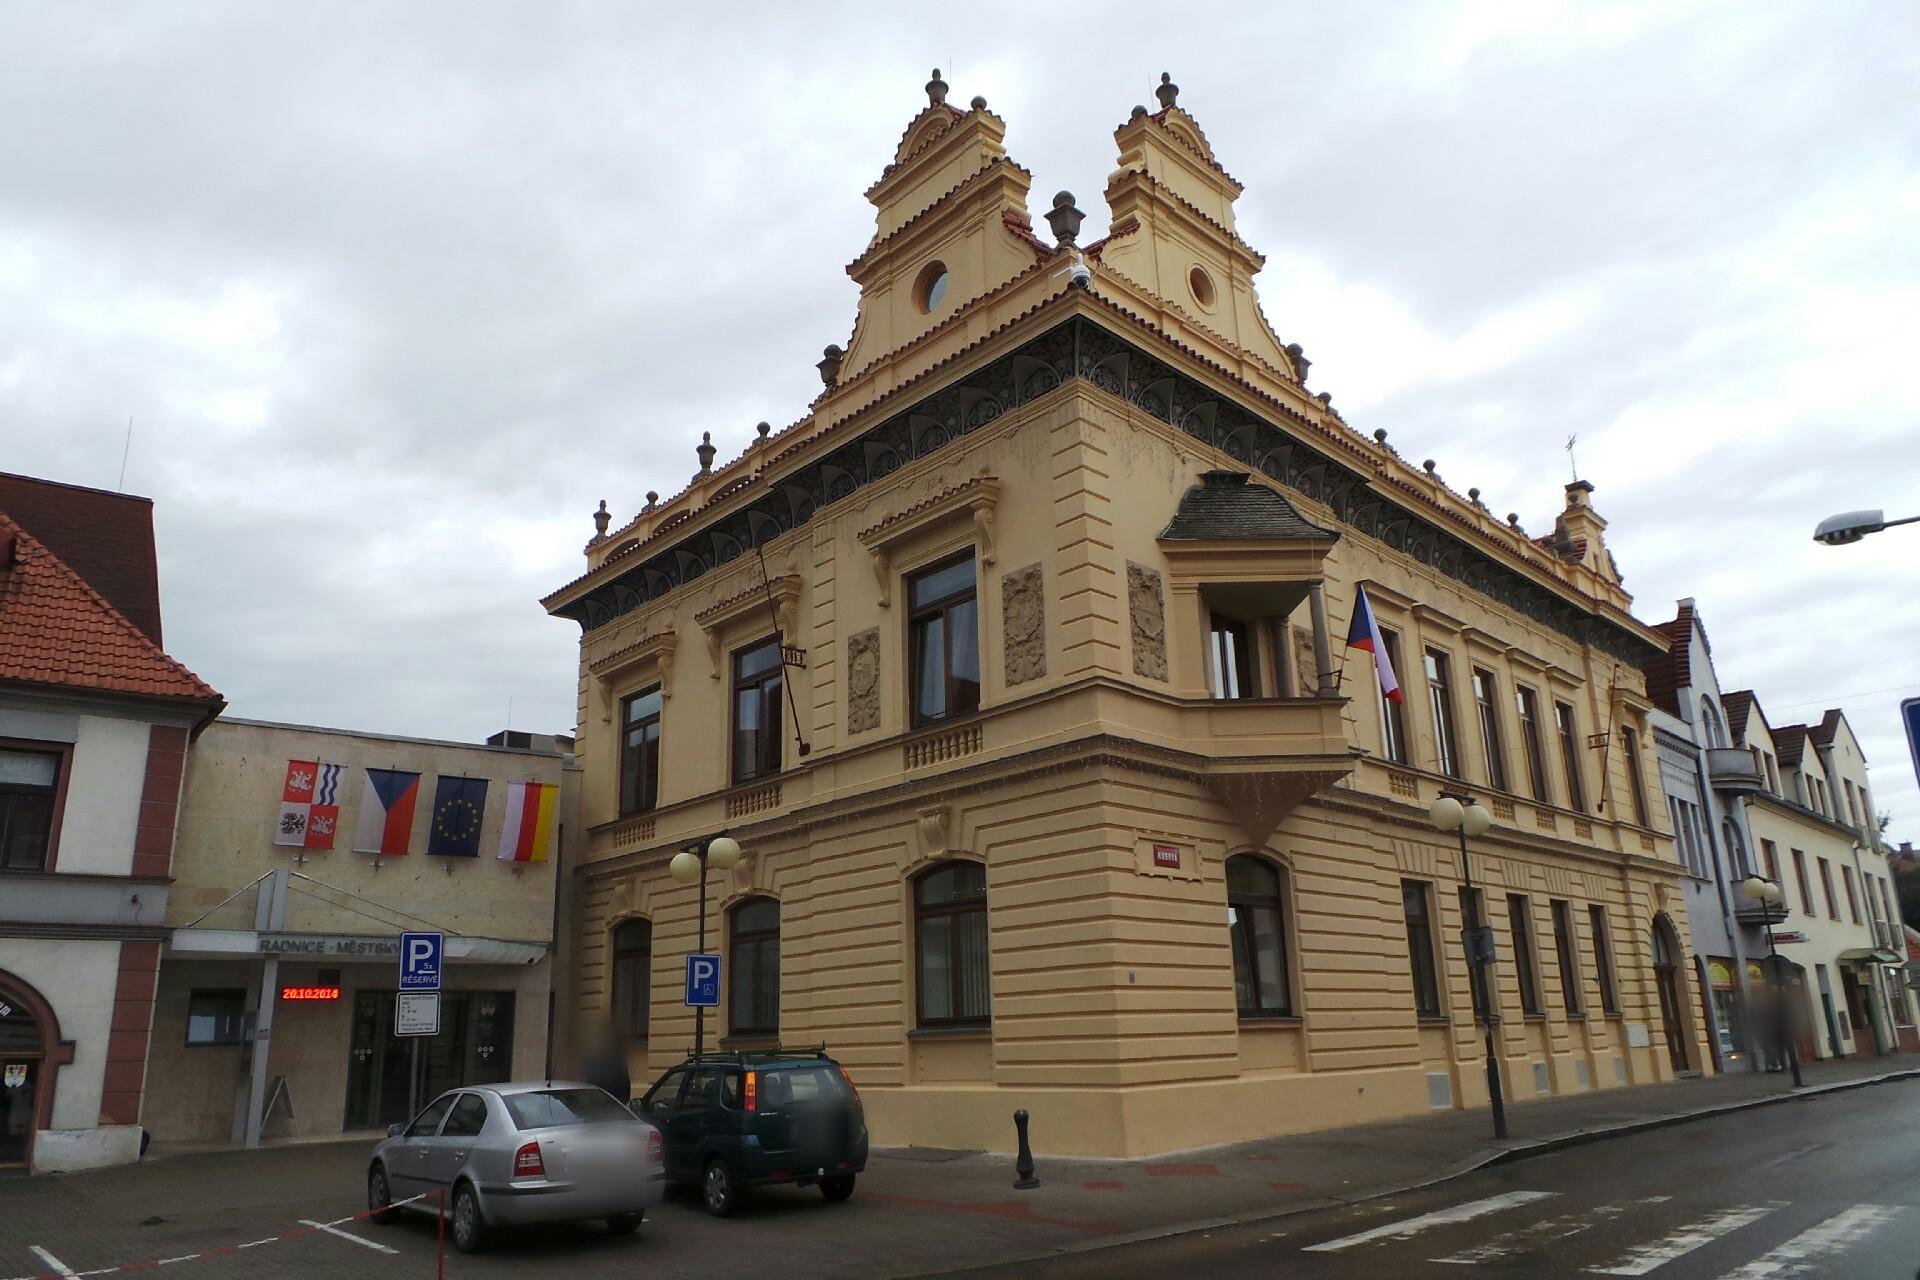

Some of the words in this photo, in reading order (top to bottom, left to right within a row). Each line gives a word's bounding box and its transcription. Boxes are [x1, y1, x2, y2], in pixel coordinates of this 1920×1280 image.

[260, 939, 326, 952] RADNICE
[409, 940, 434, 972] P
[694, 961, 714, 989] P
[282, 988, 339, 999] 20.10.2014
